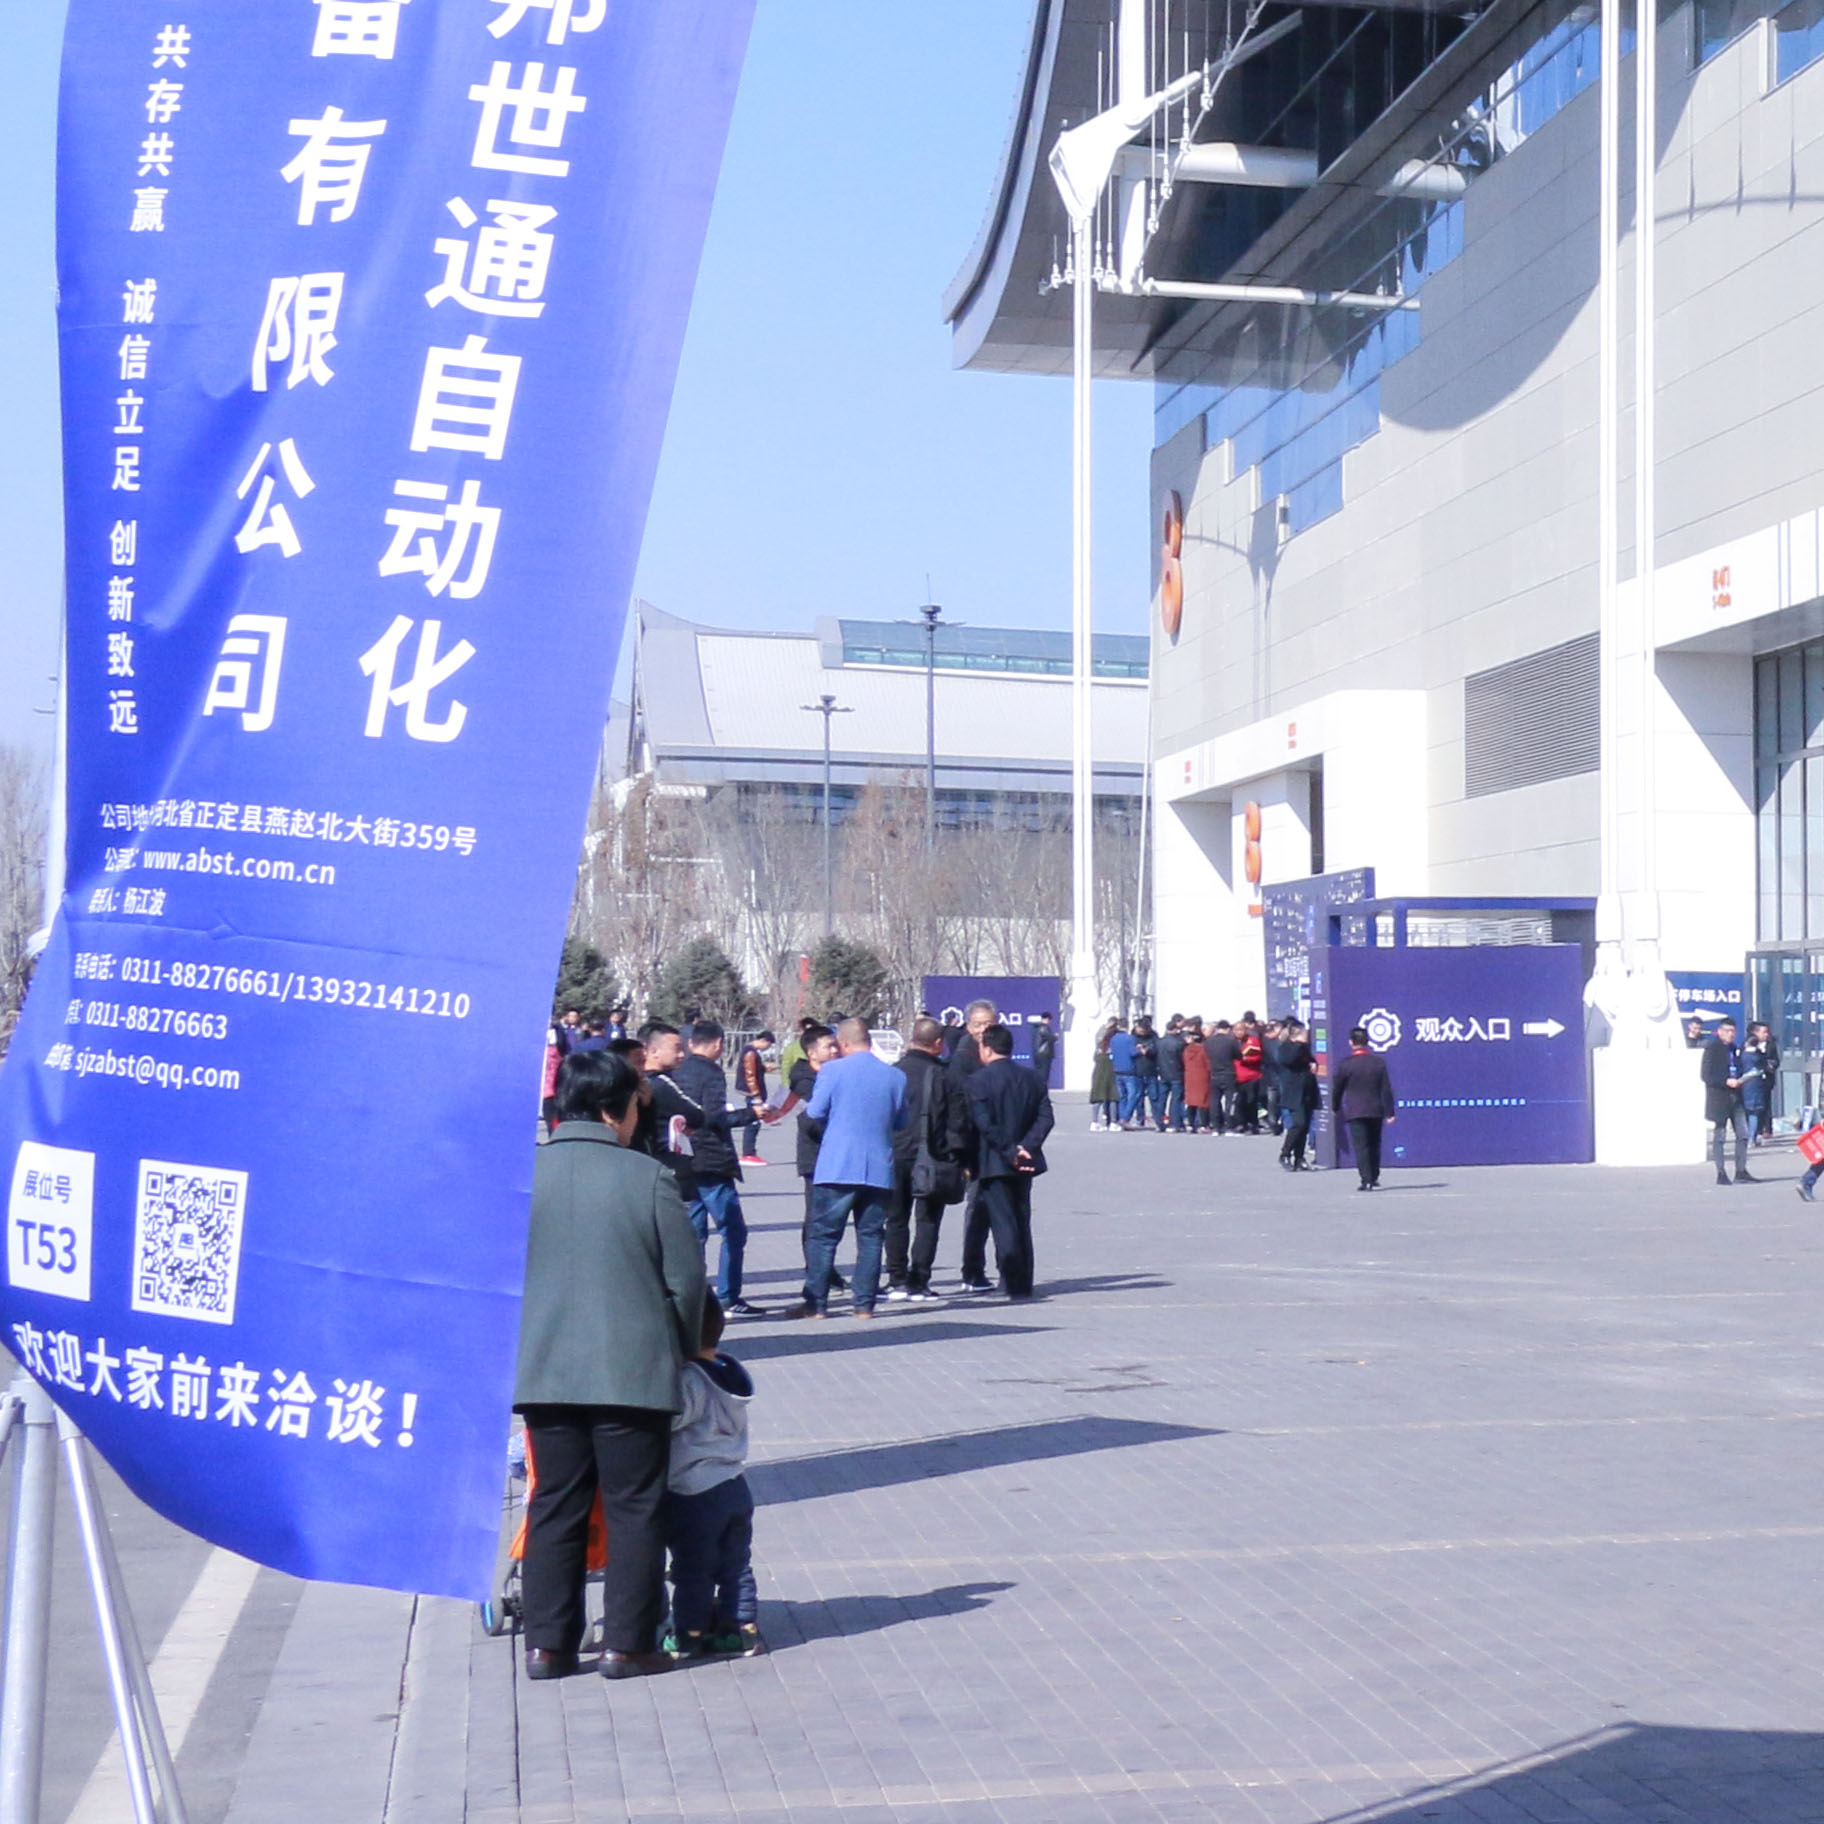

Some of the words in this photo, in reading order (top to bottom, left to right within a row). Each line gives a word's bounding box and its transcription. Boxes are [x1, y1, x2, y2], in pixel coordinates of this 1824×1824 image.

[130, 24, 192, 234] 共存共赢
[111, 277, 157, 493] 诚信立足
[107, 518, 140, 736] 创新致远
[143, 846, 335, 885] www.abst.com.cn
[121, 956, 471, 1020] 0311-88276661/13932141210
[86, 1000, 229, 1040] 0311-88276663
[1415, 1017, 1511, 1042] 观众入口
[75, 1046, 241, 1090] sjzabst@qq.com
[23, 1168, 73, 1205] 展位号
[15, 1218, 78, 1275] T53
[11, 1320, 419, 1449] 欢迎大家前来洽谈！
